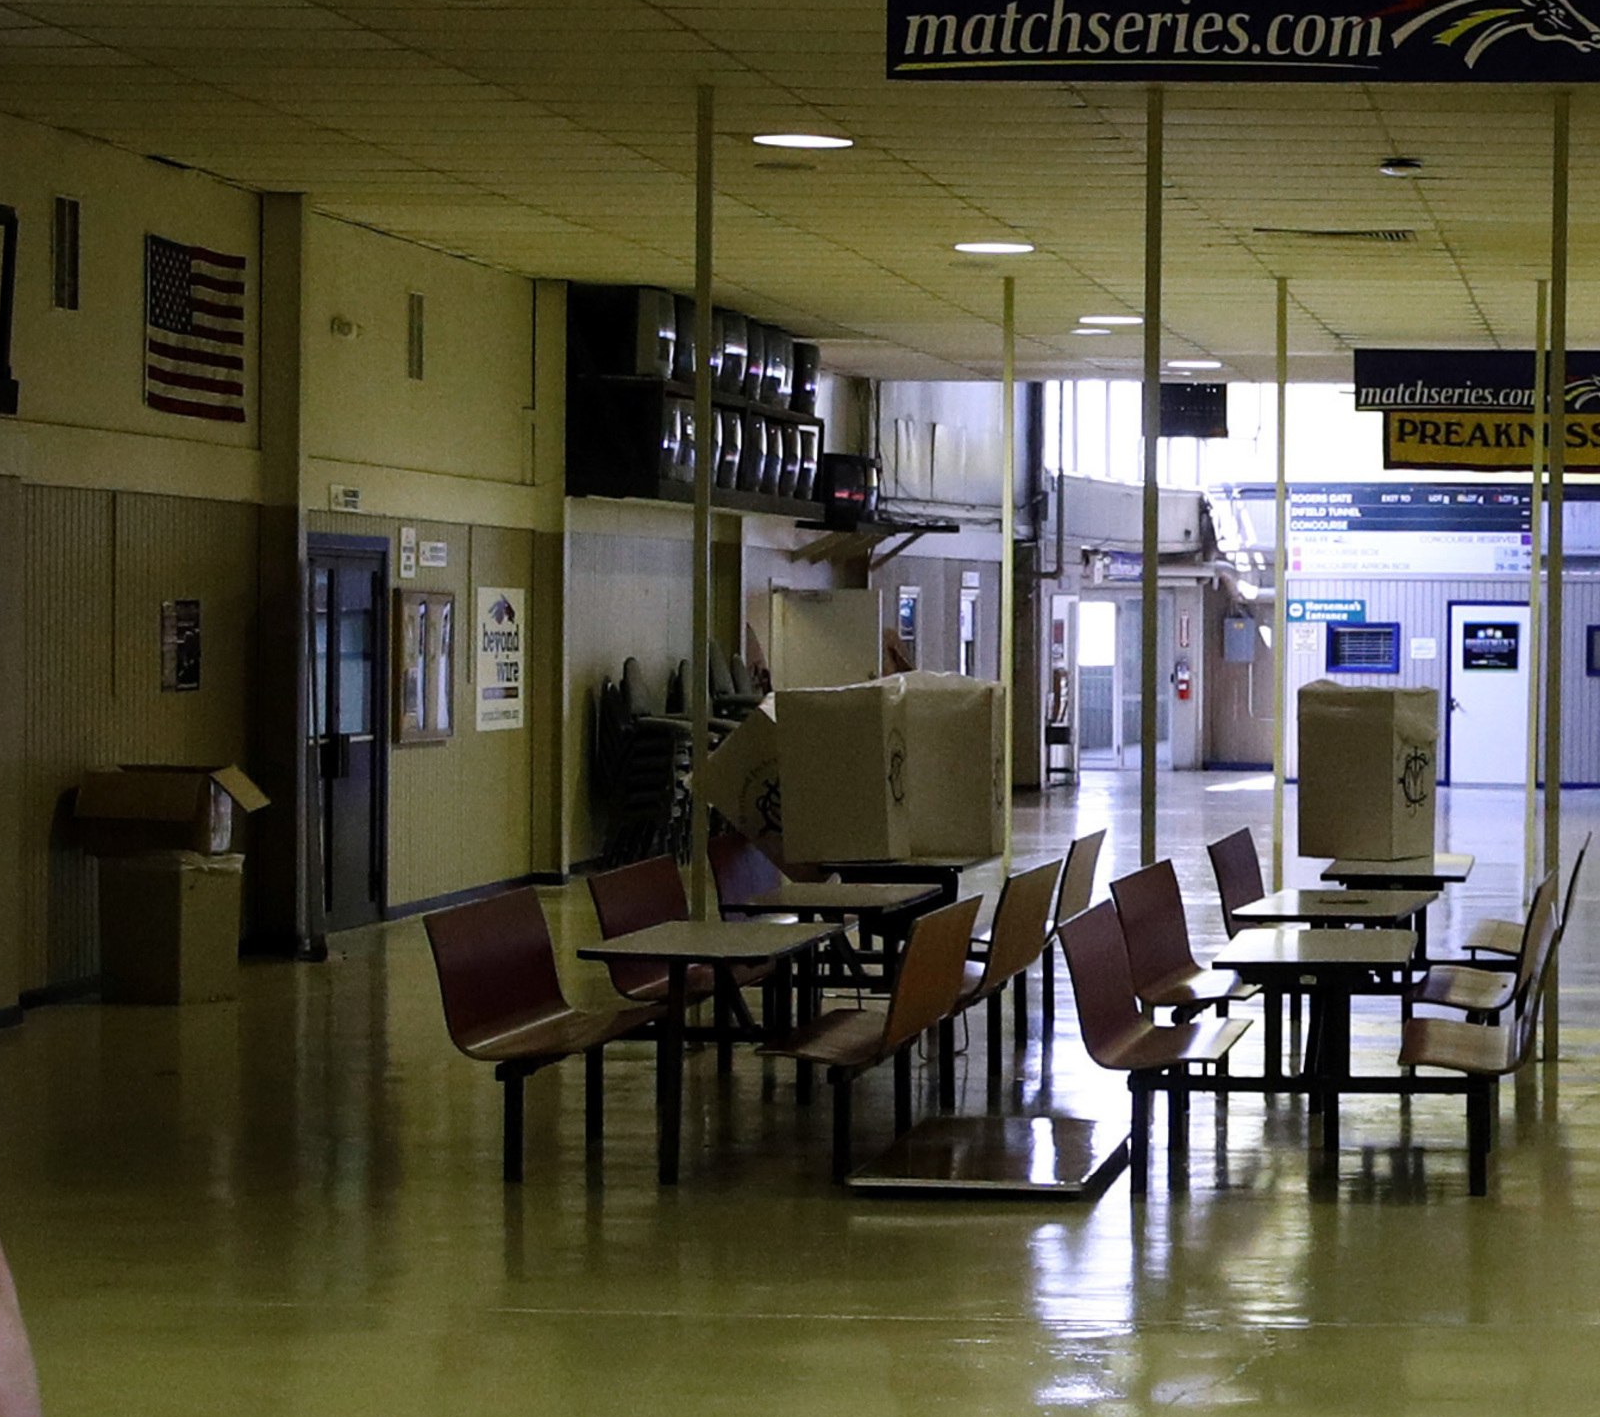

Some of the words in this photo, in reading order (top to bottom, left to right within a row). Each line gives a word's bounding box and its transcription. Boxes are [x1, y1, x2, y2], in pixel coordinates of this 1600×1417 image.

[1381, 494, 1399, 503] EXIT
[1291, 520, 1348, 530] CONCOURSE
[1305, 611, 1349, 621] Entrance
[482, 623, 520, 660] beyond
